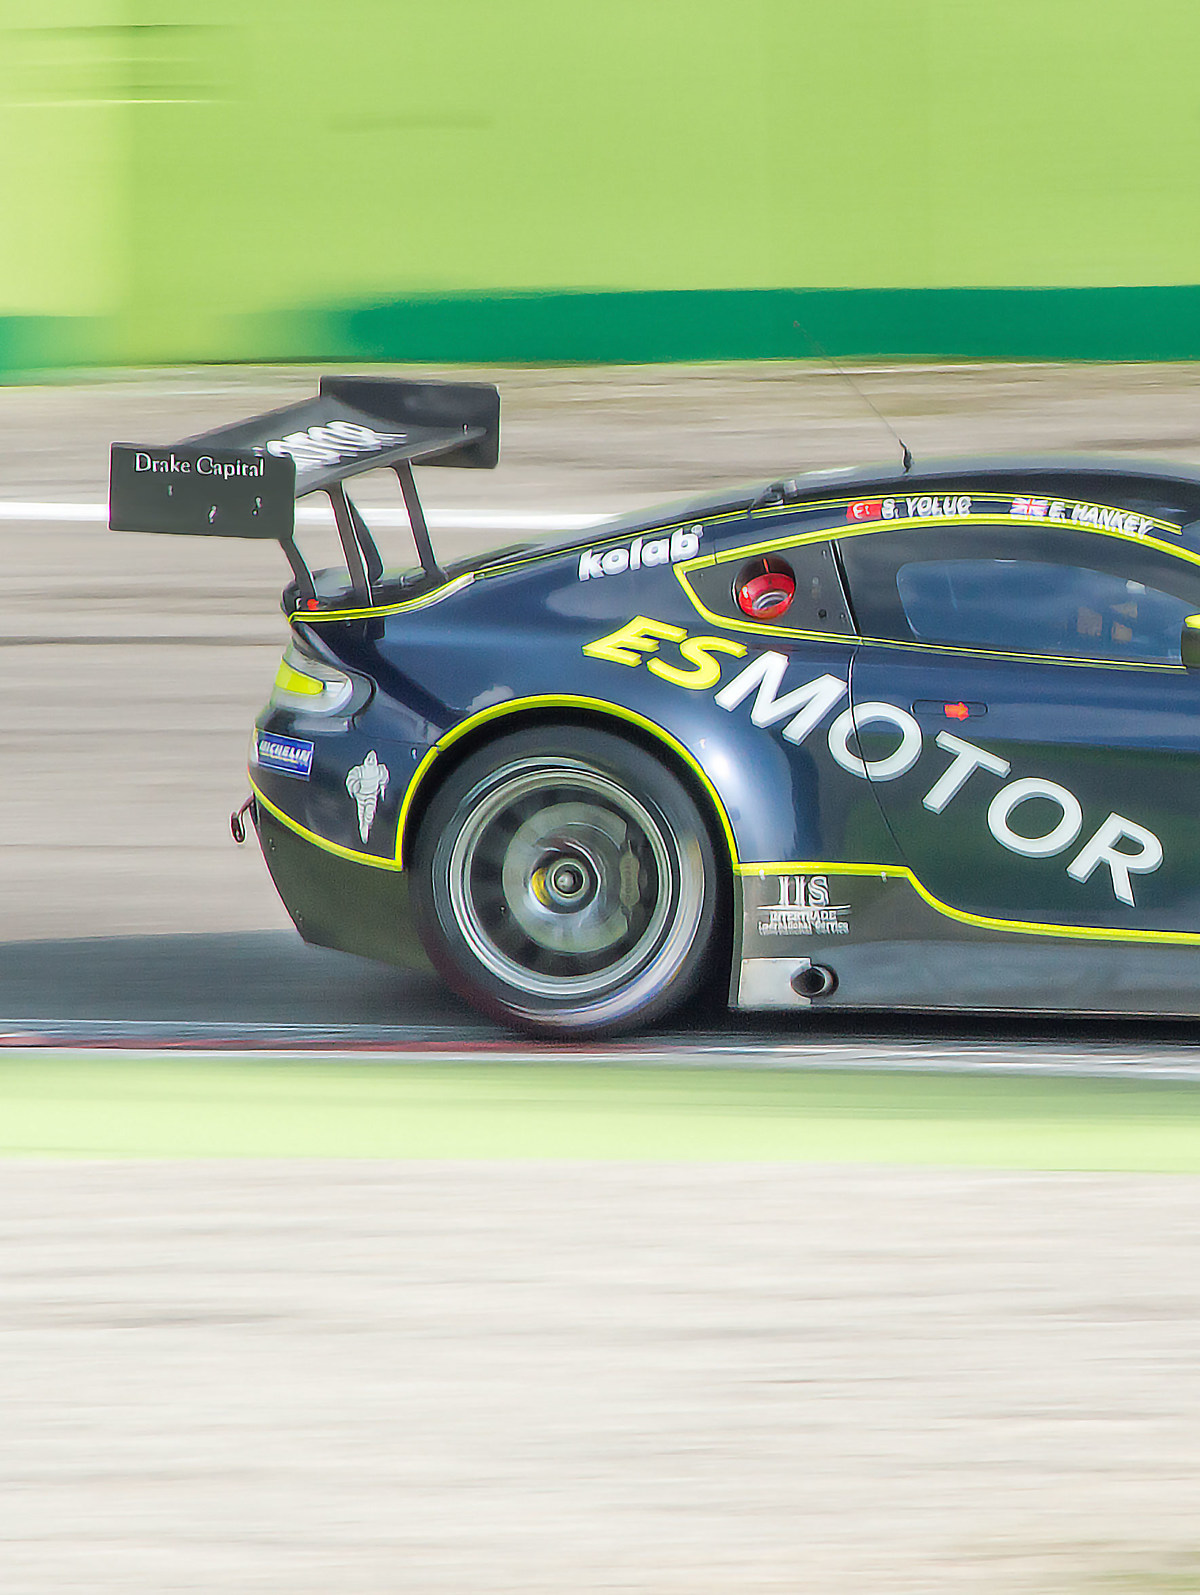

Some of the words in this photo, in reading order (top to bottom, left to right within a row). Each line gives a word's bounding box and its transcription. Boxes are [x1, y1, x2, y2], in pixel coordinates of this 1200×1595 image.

[135, 452, 191, 473] Drake
[196, 456, 264, 480] Capital
[1071, 504, 1155, 540] HANKEY
